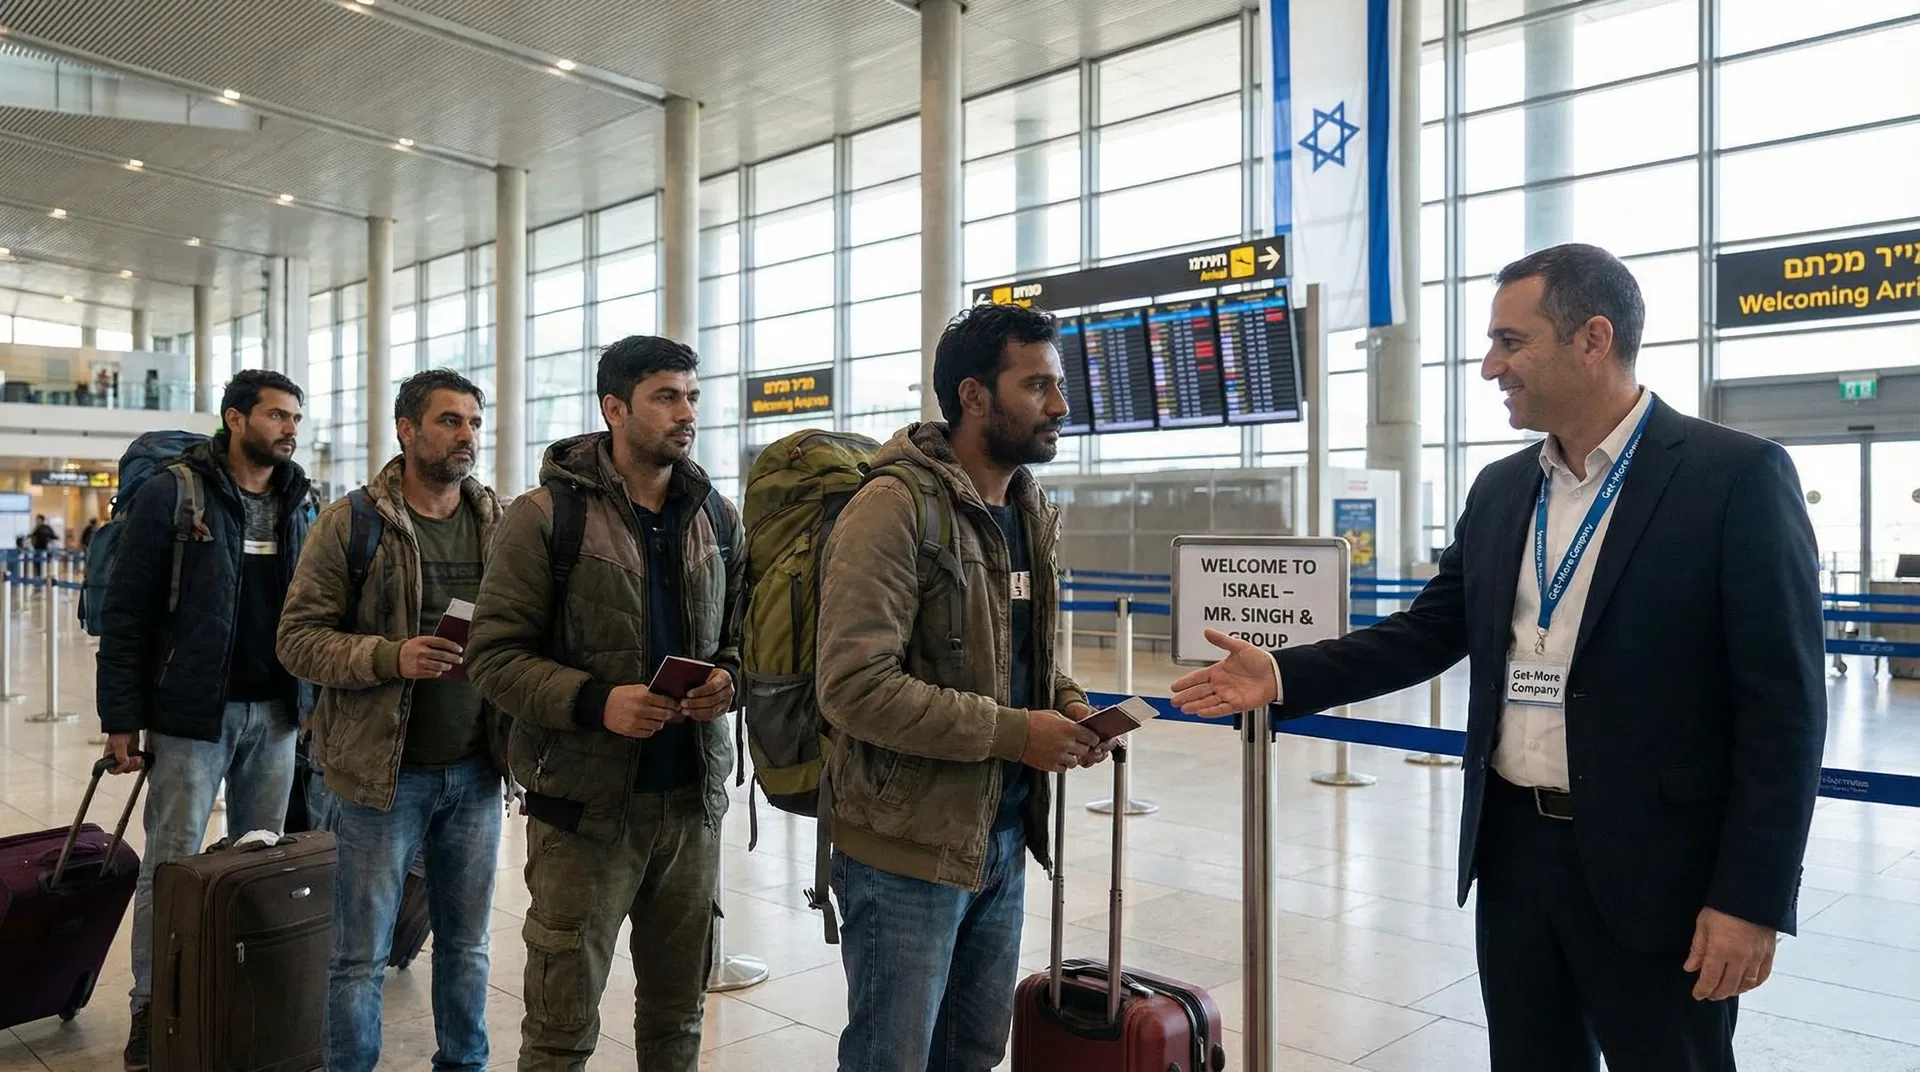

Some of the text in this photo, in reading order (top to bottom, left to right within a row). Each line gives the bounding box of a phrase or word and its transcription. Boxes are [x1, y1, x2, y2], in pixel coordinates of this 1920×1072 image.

[1739, 285, 1869, 315] Welcoming
[1201, 558, 1317, 575] WELCOME TO
[1548, 559, 1574, 601] Get-More
[1223, 582, 1279, 598] ISRAEL
[1204, 606, 1314, 625] MR. SINGH &
[1513, 669, 1561, 682] Get-More
[1511, 682, 1560, 698] Company
